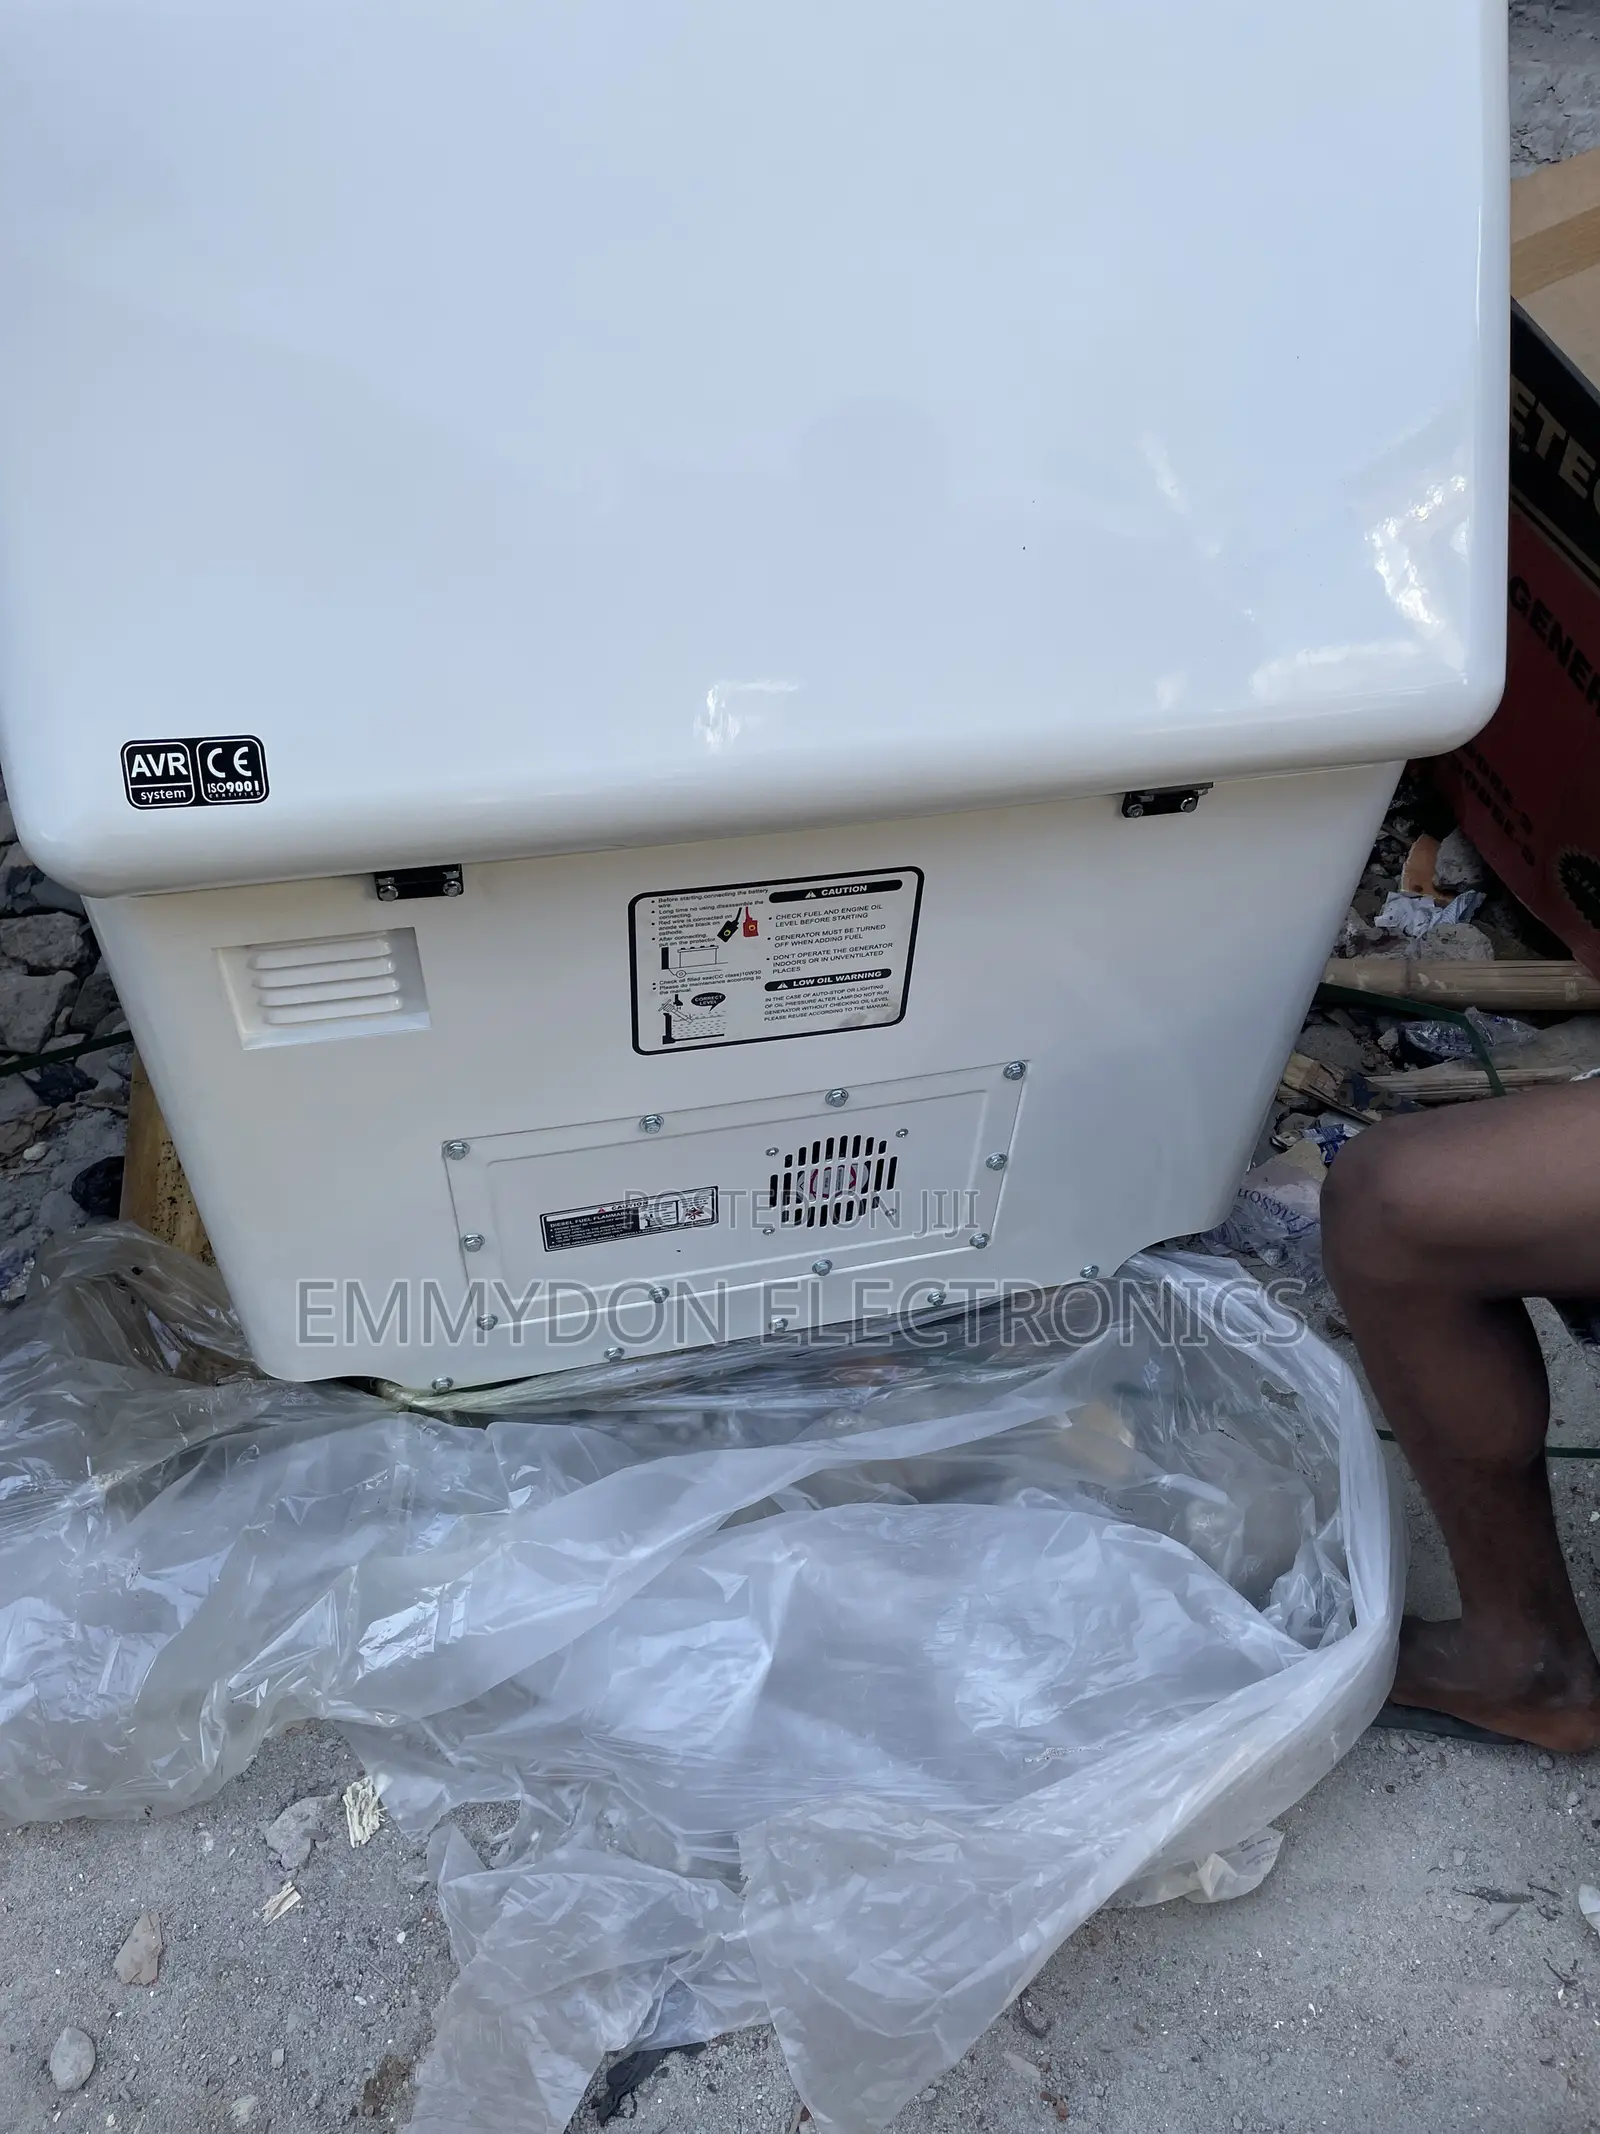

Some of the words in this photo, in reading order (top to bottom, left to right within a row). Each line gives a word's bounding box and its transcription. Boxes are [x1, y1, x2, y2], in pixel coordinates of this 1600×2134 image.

[1510, 373, 1600, 513] ETE
[131, 752, 188, 778] AVR
[206, 746, 252, 778] CE
[207, 780, 260, 794] ISO9001
[140, 788, 186, 803] system
[748, 888, 769, 896] battery
[821, 885, 868, 897] CAUTION
[692, 914, 724, 922] connected
[775, 912, 802, 921] CHECK
[803, 910, 822, 919] FUEL
[823, 908, 840, 916] AND
[841, 905, 870, 914] ENGINE
[775, 920, 799, 928] LEVEL
[799, 916, 830, 925] BEFORE
[831, 912, 869, 922] STARTING
[774, 931, 821, 941] GENERATOR
[822, 929, 843, 937] MUST
[855, 924, 886, 933] TURNED
[774, 941, 789, 949] OFF
[791, 938, 815, 947] WHEN
[815, 935, 843, 944] ADDING
[844, 933, 863, 941] FUEL
[772, 958, 807, 968] INDOORS
[830, 950, 884, 961] UNVENTILATED
[773, 953, 795, 961] DON'T
[797, 949, 831, 959] OPERATE
[832, 947, 847, 955] THE
[848, 942, 894, 953] GENERATOR
[772, 966, 801, 974] PLACES
[792, 978, 815, 987] LOW
[816, 976, 833, 985] OIL
[835, 970, 883, 981] WARNING
[694, 994, 723, 1002] CORRECT
[785, 998, 817, 1007] PRESSURE
[817, 996, 836, 1004] ALTER
[876, 989, 890, 997] RUN
[811, 988, 846, 997] AUTO-STOP
[856, 984, 884, 993] LIGHTING
[764, 1006, 801, 1016] GENERATOR
[801, 1003, 828, 1012] WITHOUT
[829, 999, 860, 1008] CHECKING
[764, 1014, 787, 1022] PLEASE
[787, 1012, 808, 1020] REUSE
[808, 1008, 843, 1017] ACCORDING
[611, 1200, 649, 1211] CAUTION
[550, 1219, 574, 1228] DIESEL
[575, 1216, 592, 1225] FUEL
